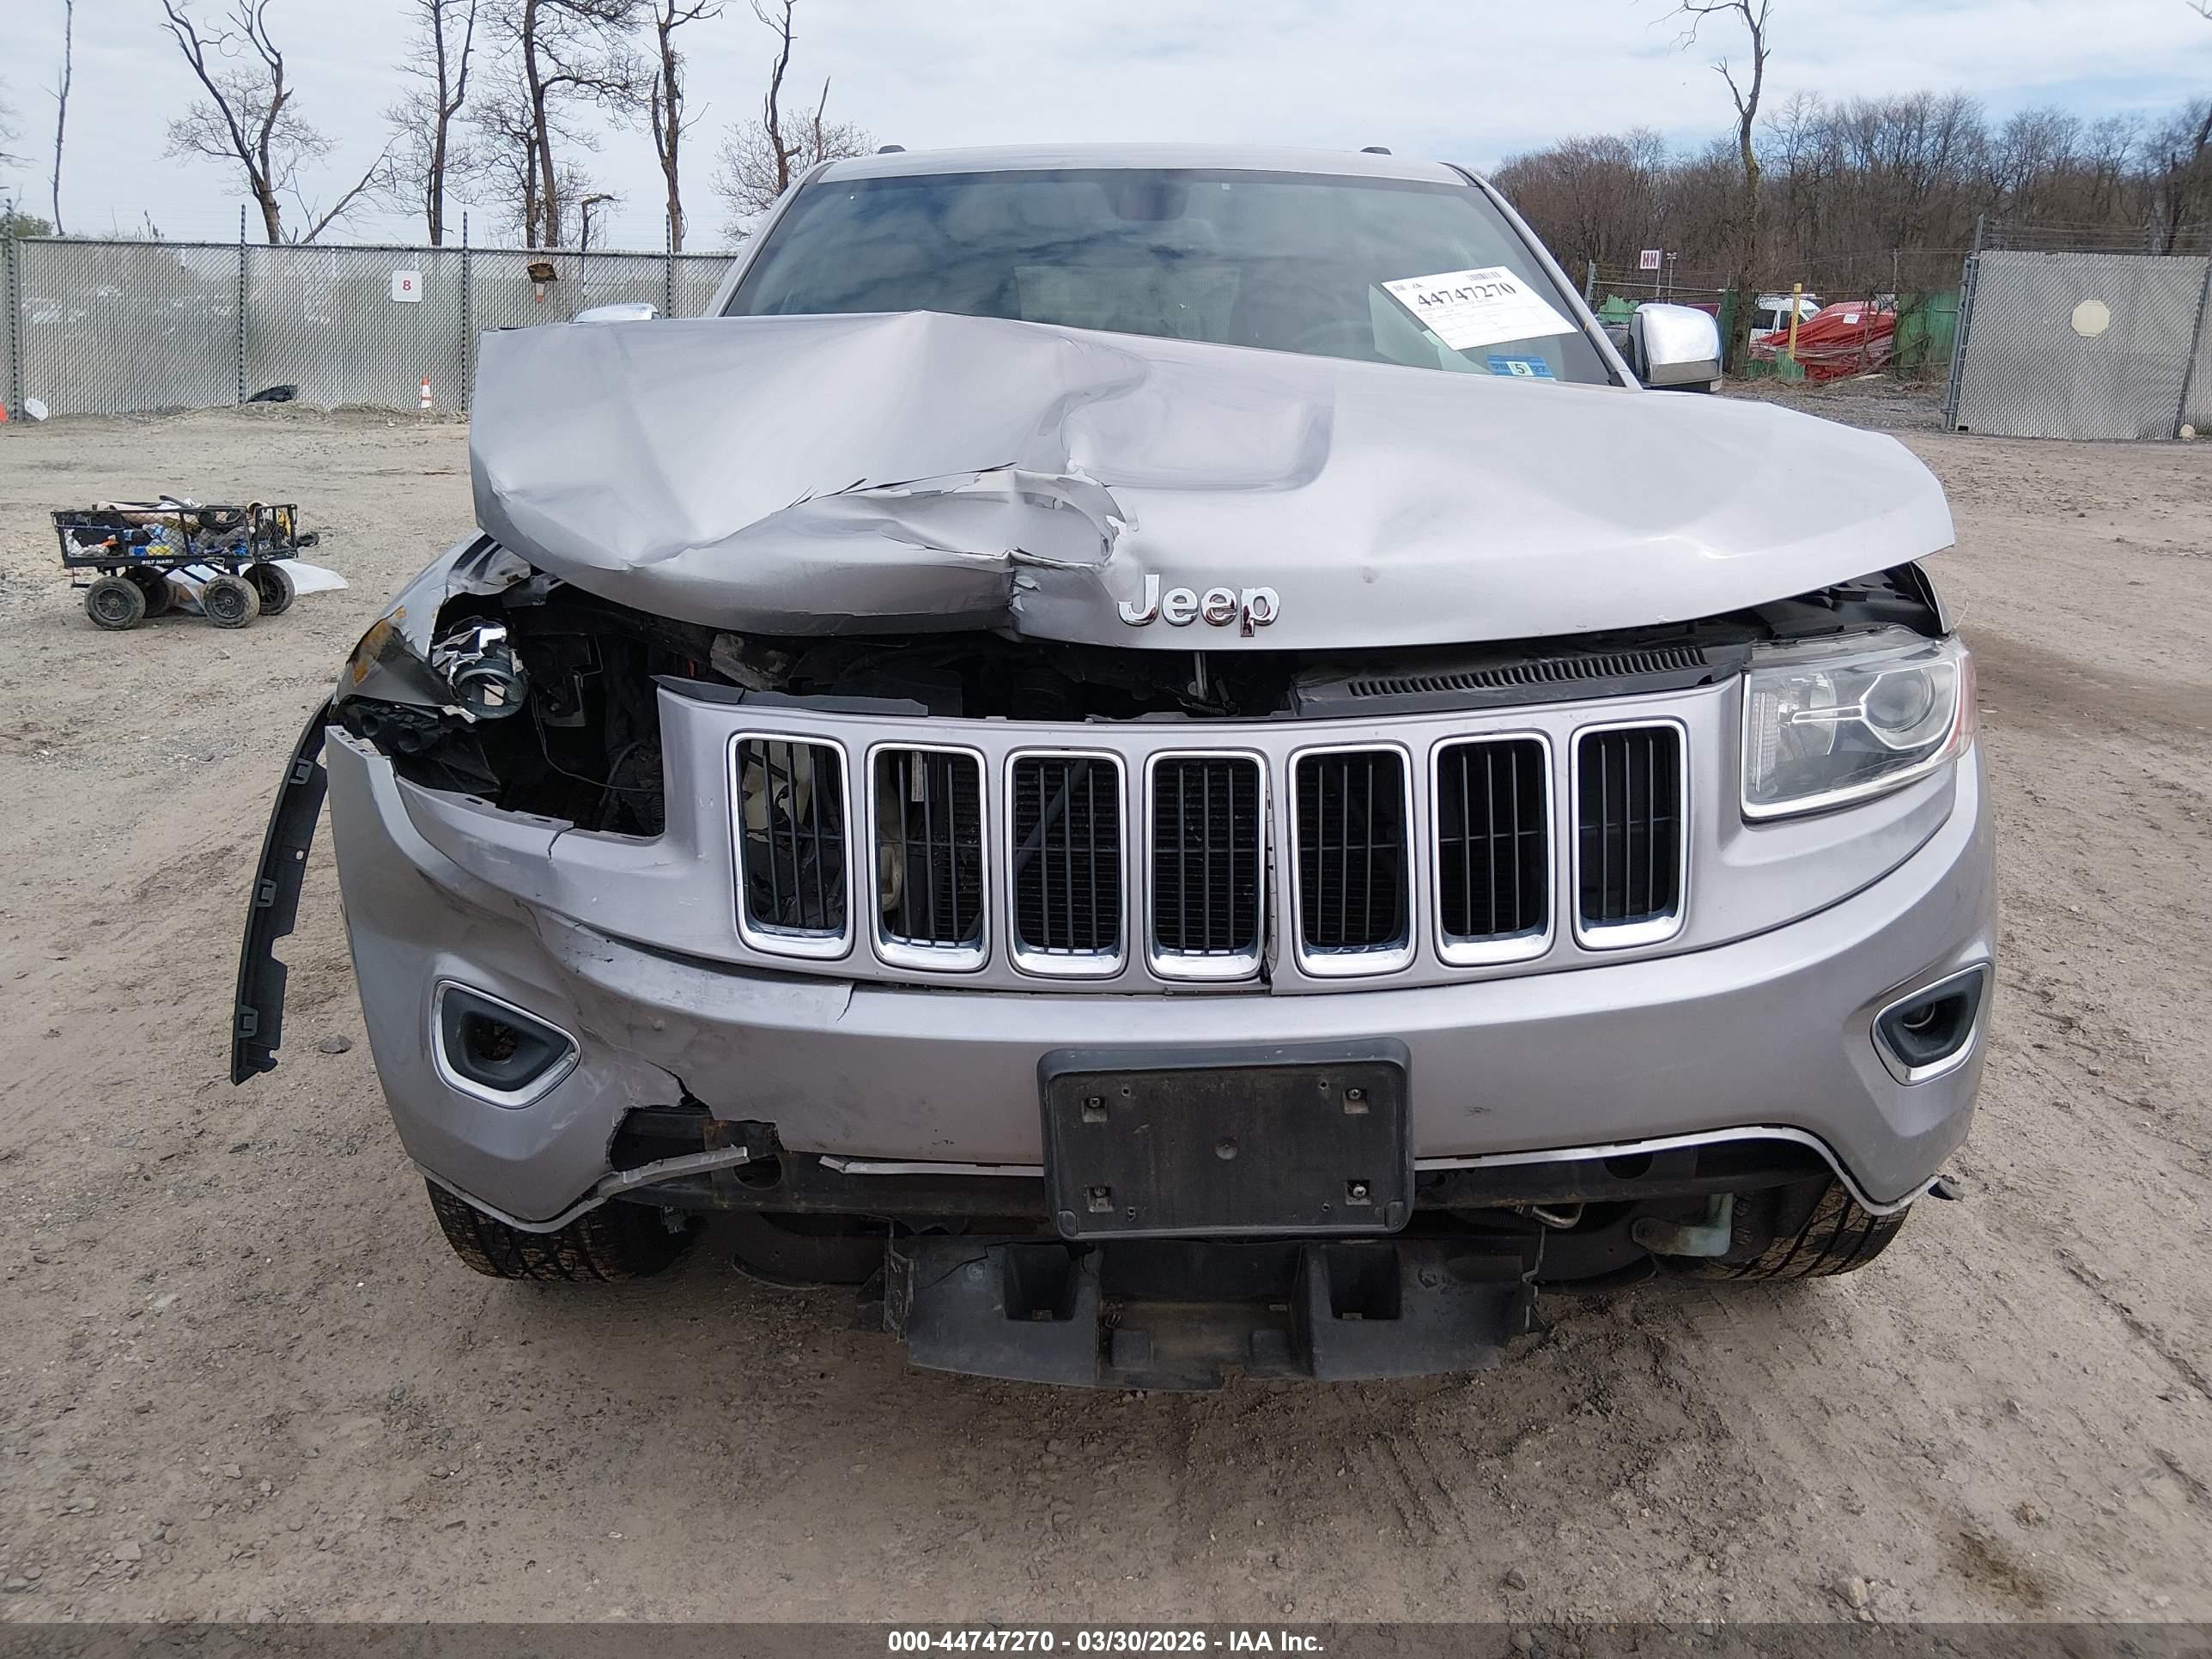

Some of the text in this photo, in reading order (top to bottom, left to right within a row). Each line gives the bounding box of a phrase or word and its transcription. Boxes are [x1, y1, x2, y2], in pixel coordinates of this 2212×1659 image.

[1642, 252, 1657, 267] HH
[402, 280, 411, 290] 8
[1418, 283, 1517, 307] 44747270
[1515, 363, 1526, 374] 5
[1117, 574, 1280, 638] Jeep
